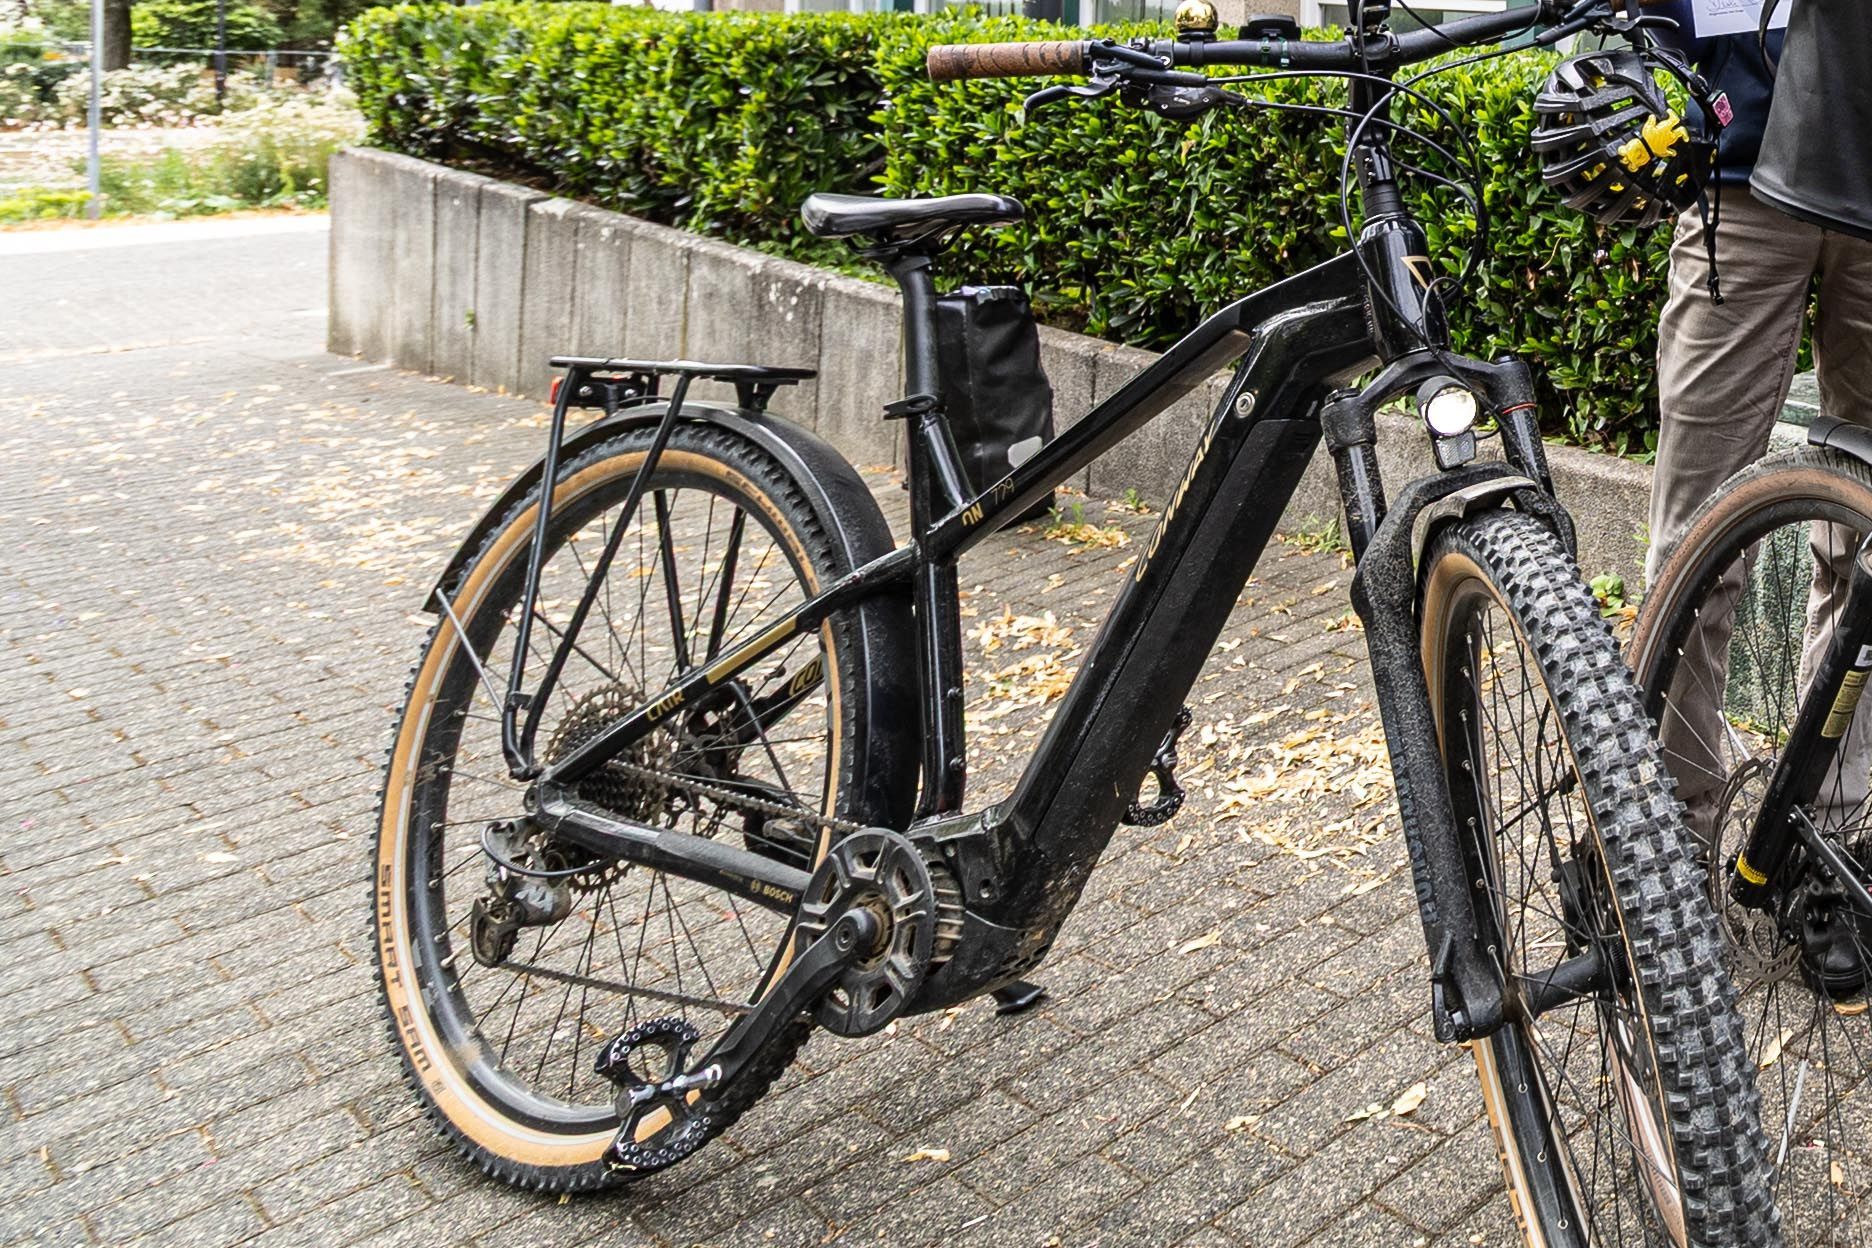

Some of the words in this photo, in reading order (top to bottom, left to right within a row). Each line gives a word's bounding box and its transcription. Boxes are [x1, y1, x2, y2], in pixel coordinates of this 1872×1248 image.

[762, 884, 794, 904] BOSCH
[380, 863, 403, 989] SMART
[398, 1005, 433, 1073] SAM
